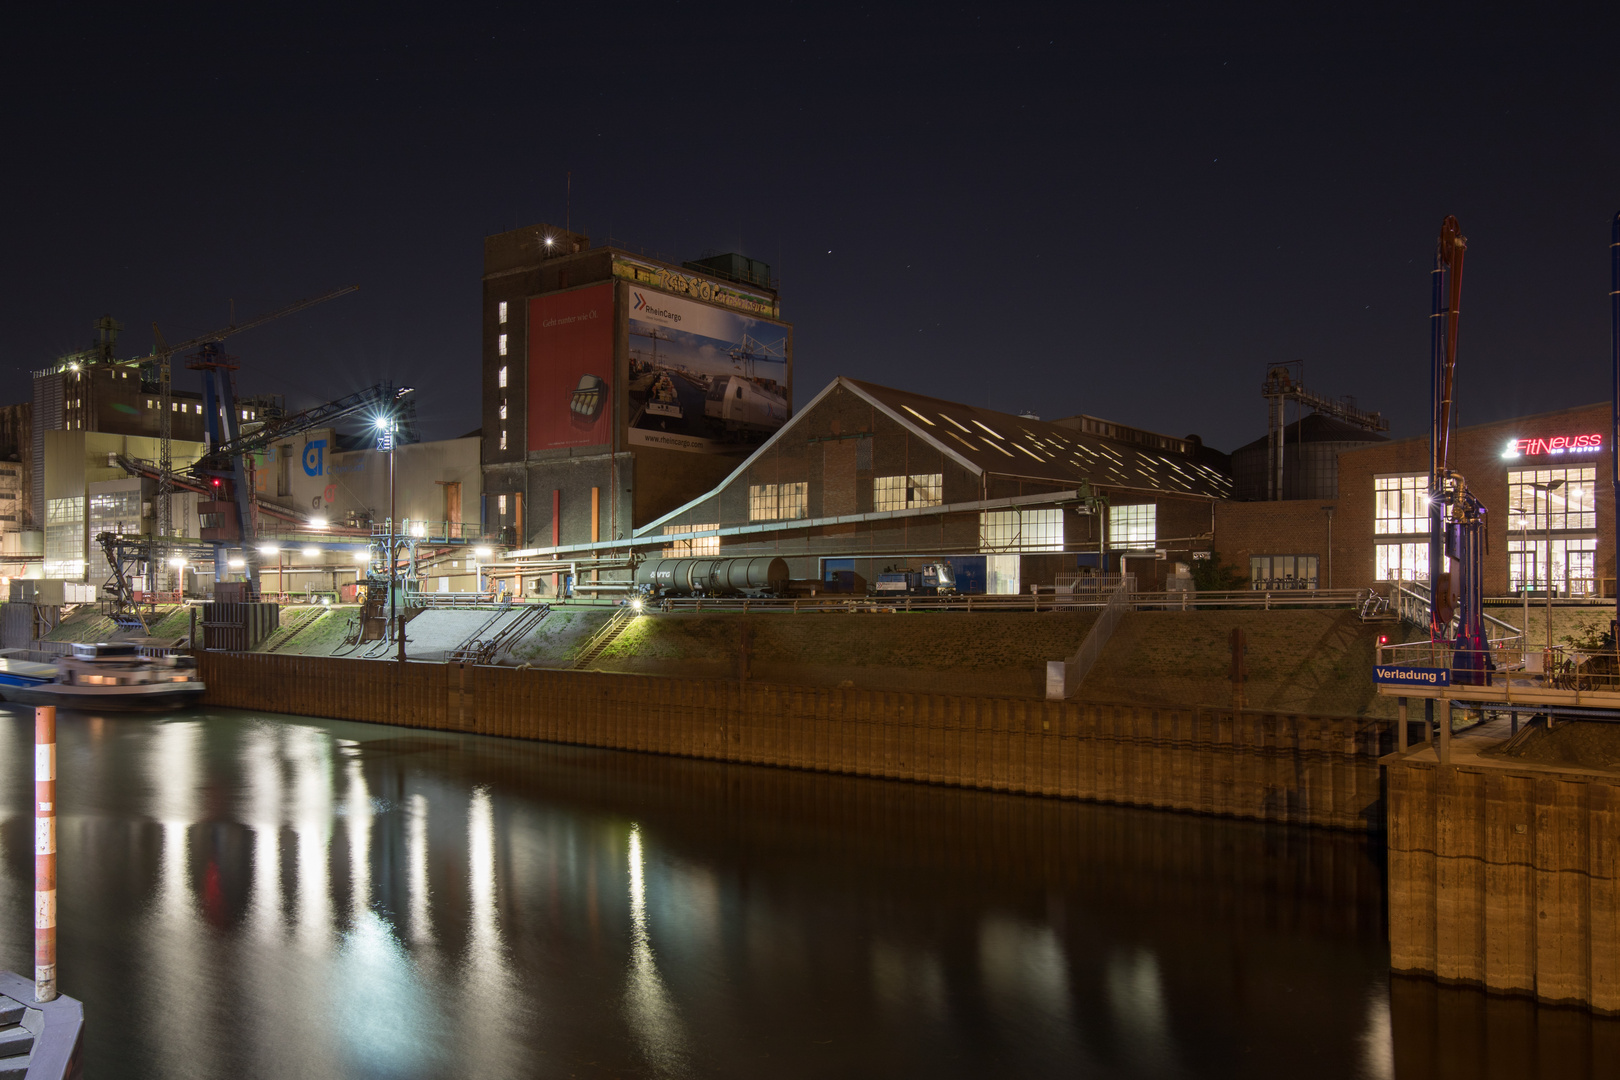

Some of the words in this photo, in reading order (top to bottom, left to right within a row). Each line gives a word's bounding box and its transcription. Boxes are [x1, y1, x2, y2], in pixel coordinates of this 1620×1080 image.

[645, 305, 682, 322] RheinCargo
[542, 317, 556, 328] Geht
[645, 435, 704, 448] www.rheincargo.com
[1515, 434, 1602, 455] FitNeuss
[1376, 668, 1437, 683] Verladung
[1440, 671, 1447, 681] 1
